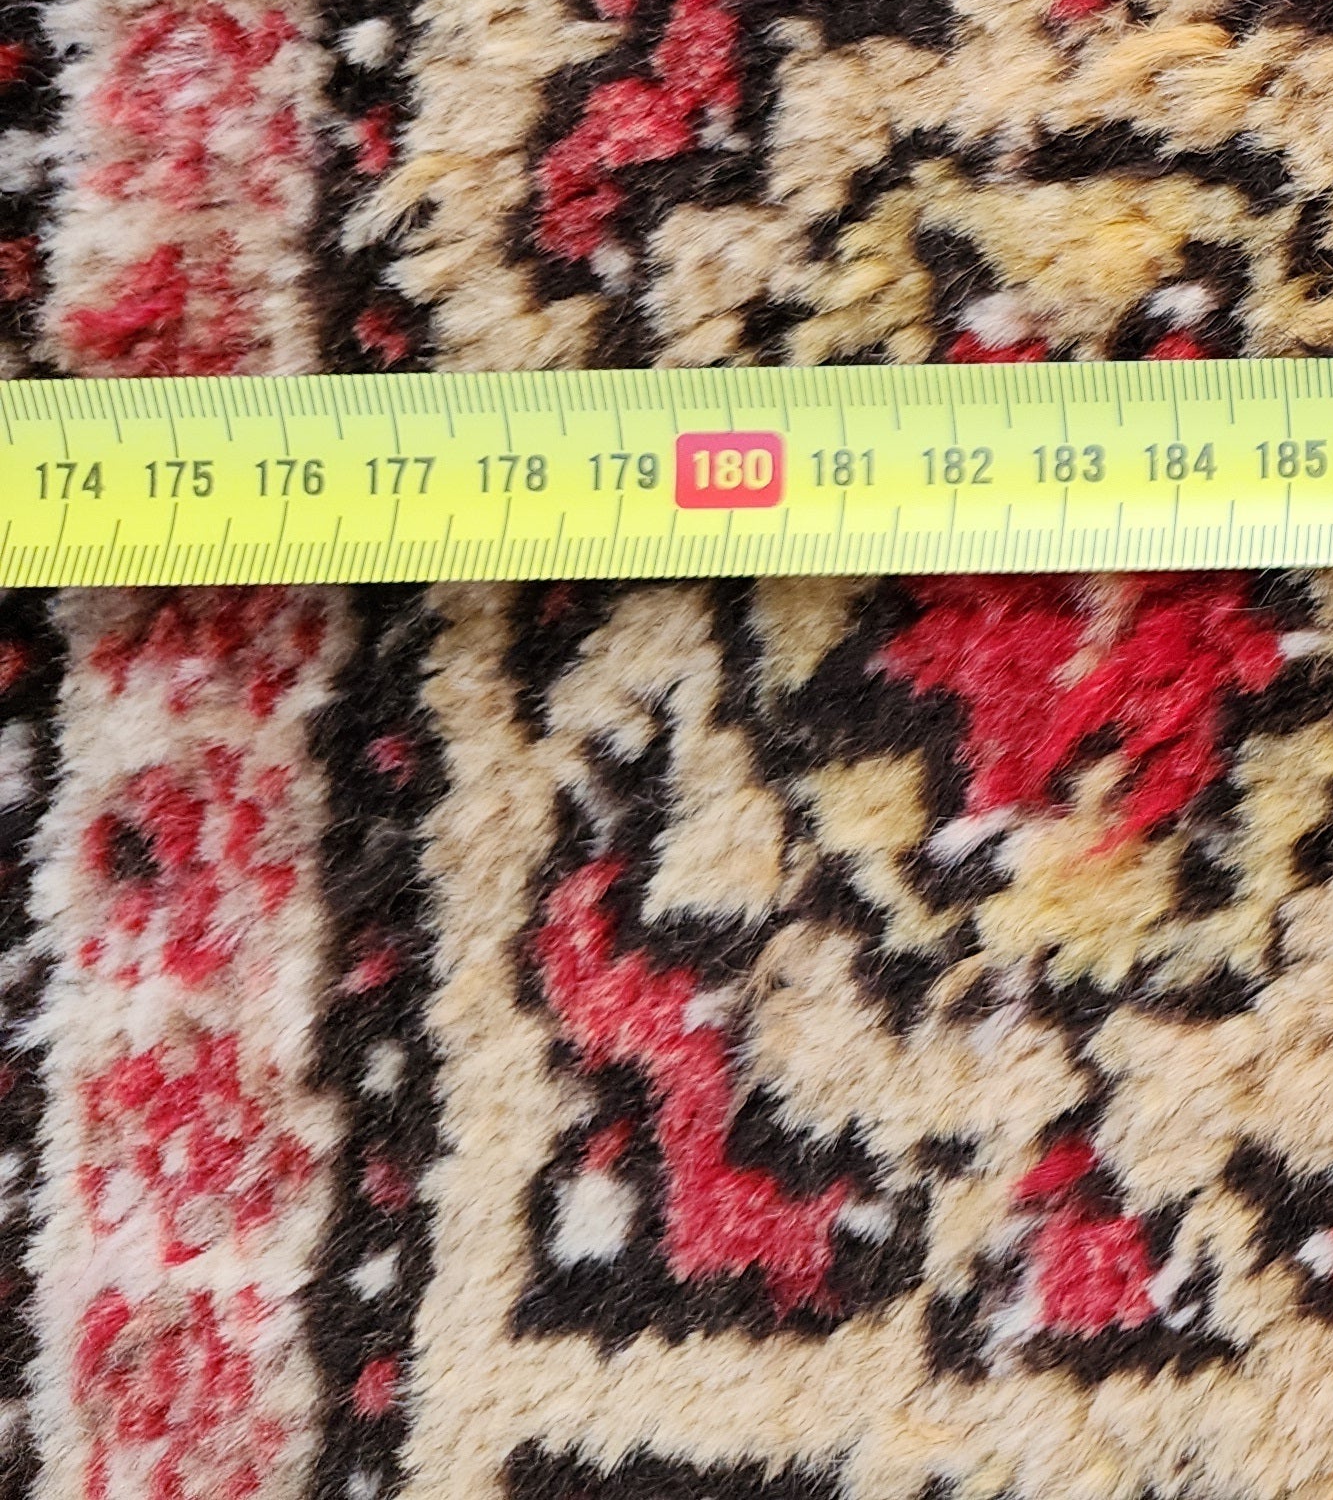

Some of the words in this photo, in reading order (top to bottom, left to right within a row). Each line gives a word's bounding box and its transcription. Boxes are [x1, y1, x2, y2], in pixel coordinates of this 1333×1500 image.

[36, 462, 103, 499] 174
[145, 461, 212, 497] 175
[256, 460, 323, 496] 176
[366, 457, 434, 494] 177
[478, 455, 546, 492] 178
[589, 453, 657, 490] 179
[692, 450, 774, 489] 180
[812, 450, 872, 486] 181
[923, 448, 992, 485] 182
[1033, 445, 1104, 483] 183
[1145, 443, 1216, 481] 184
[1256, 440, 1326, 478] 185
